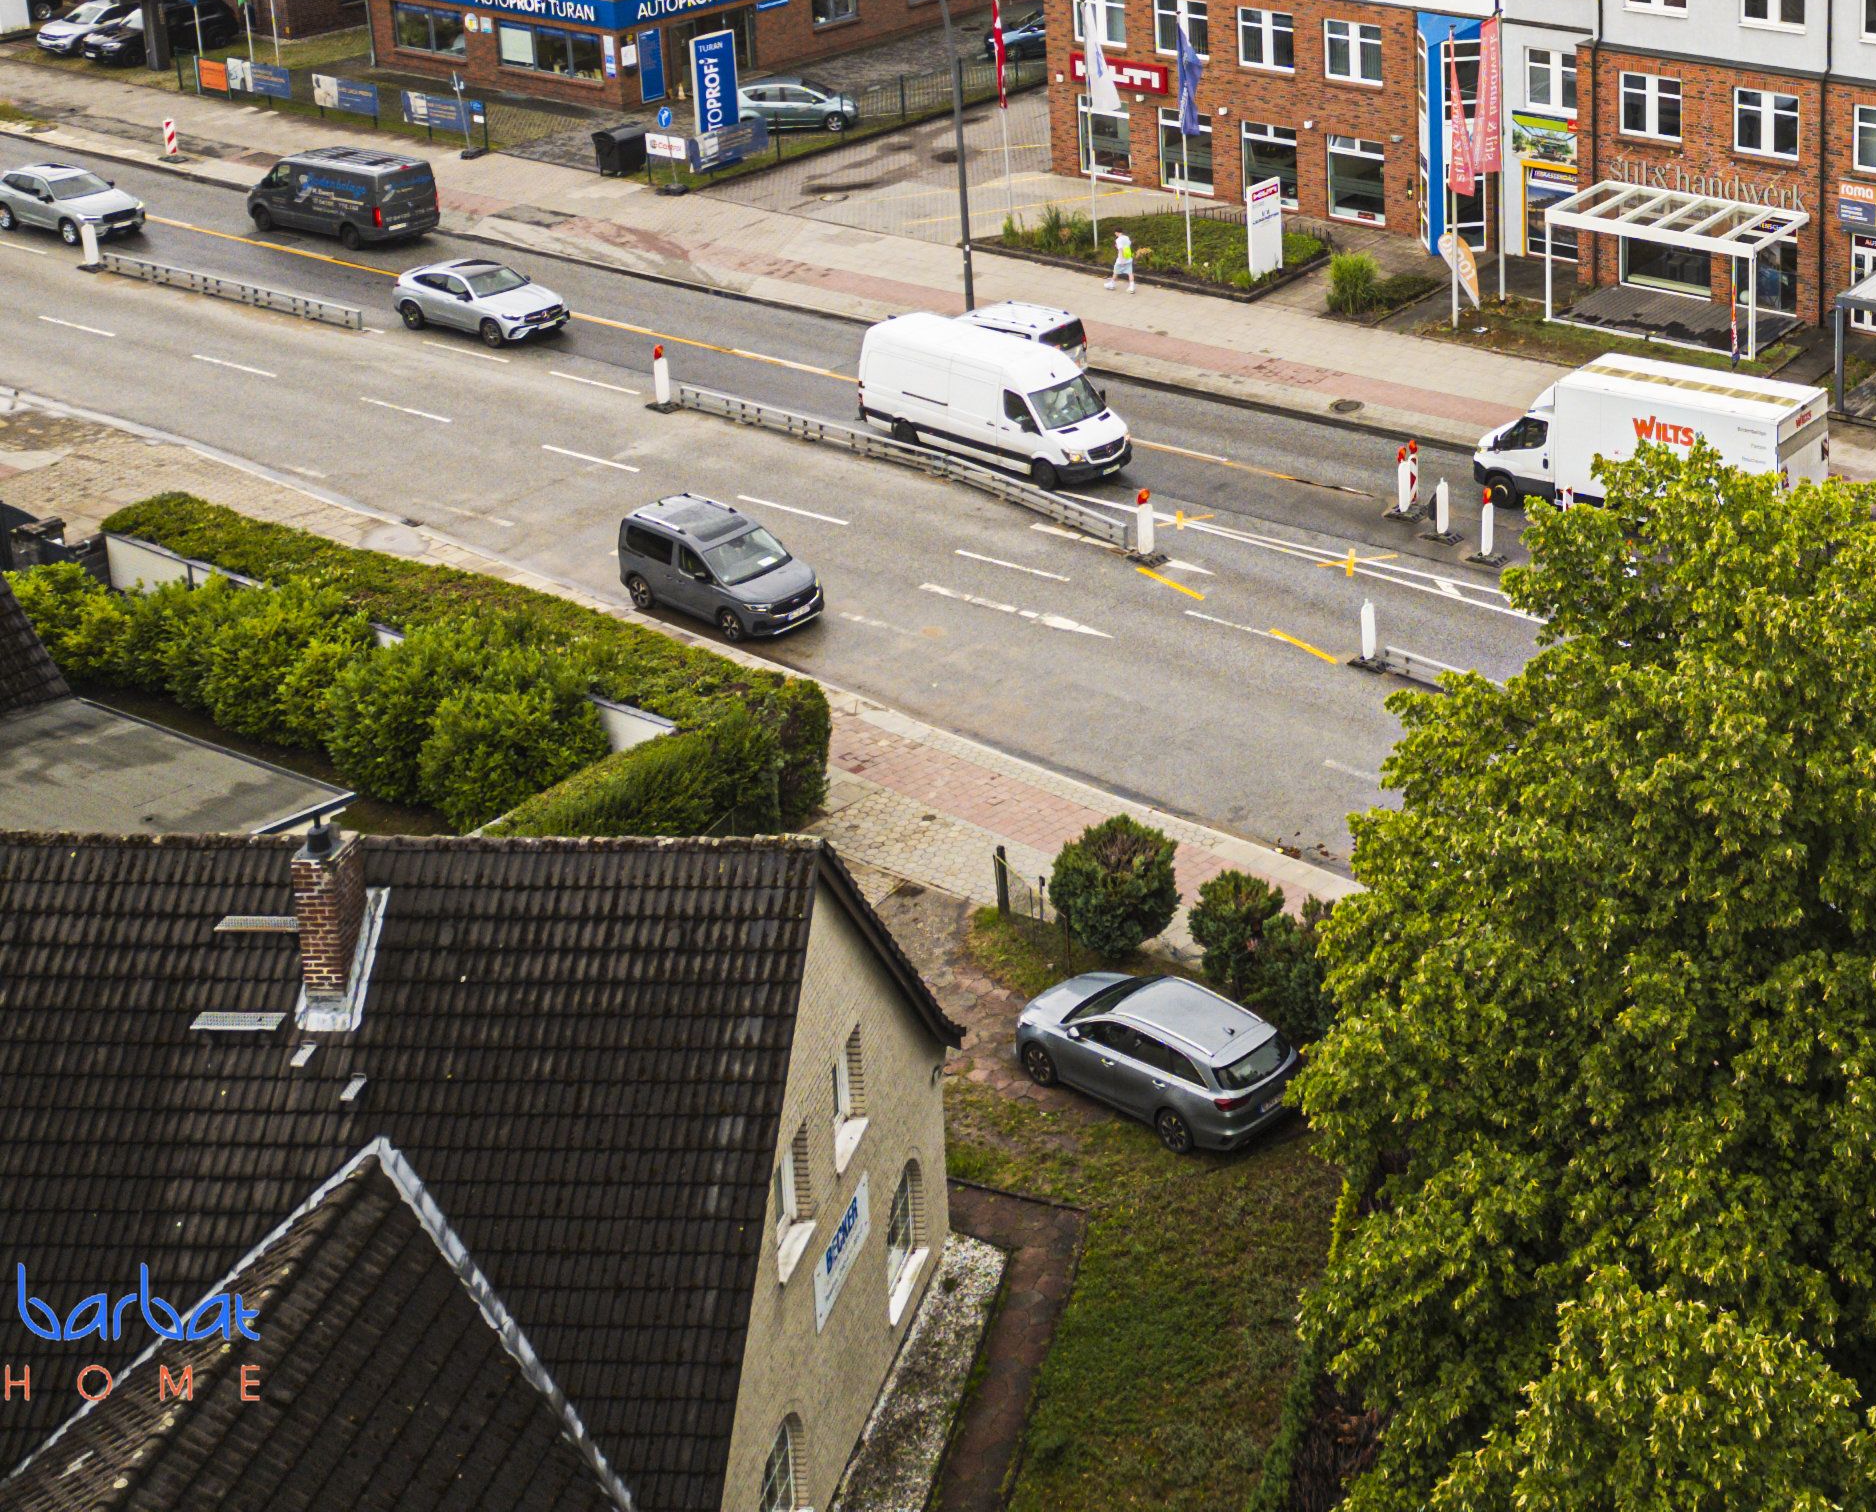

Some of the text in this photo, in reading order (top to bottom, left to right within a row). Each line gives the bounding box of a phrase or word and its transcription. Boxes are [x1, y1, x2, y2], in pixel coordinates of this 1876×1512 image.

[548, 0, 596, 22] TURAN
[1651, 167, 1669, 190] &
[1676, 165, 1809, 215] handwerk
[1840, 184, 1874, 199] roma
[1632, 415, 1695, 447] WILTS
